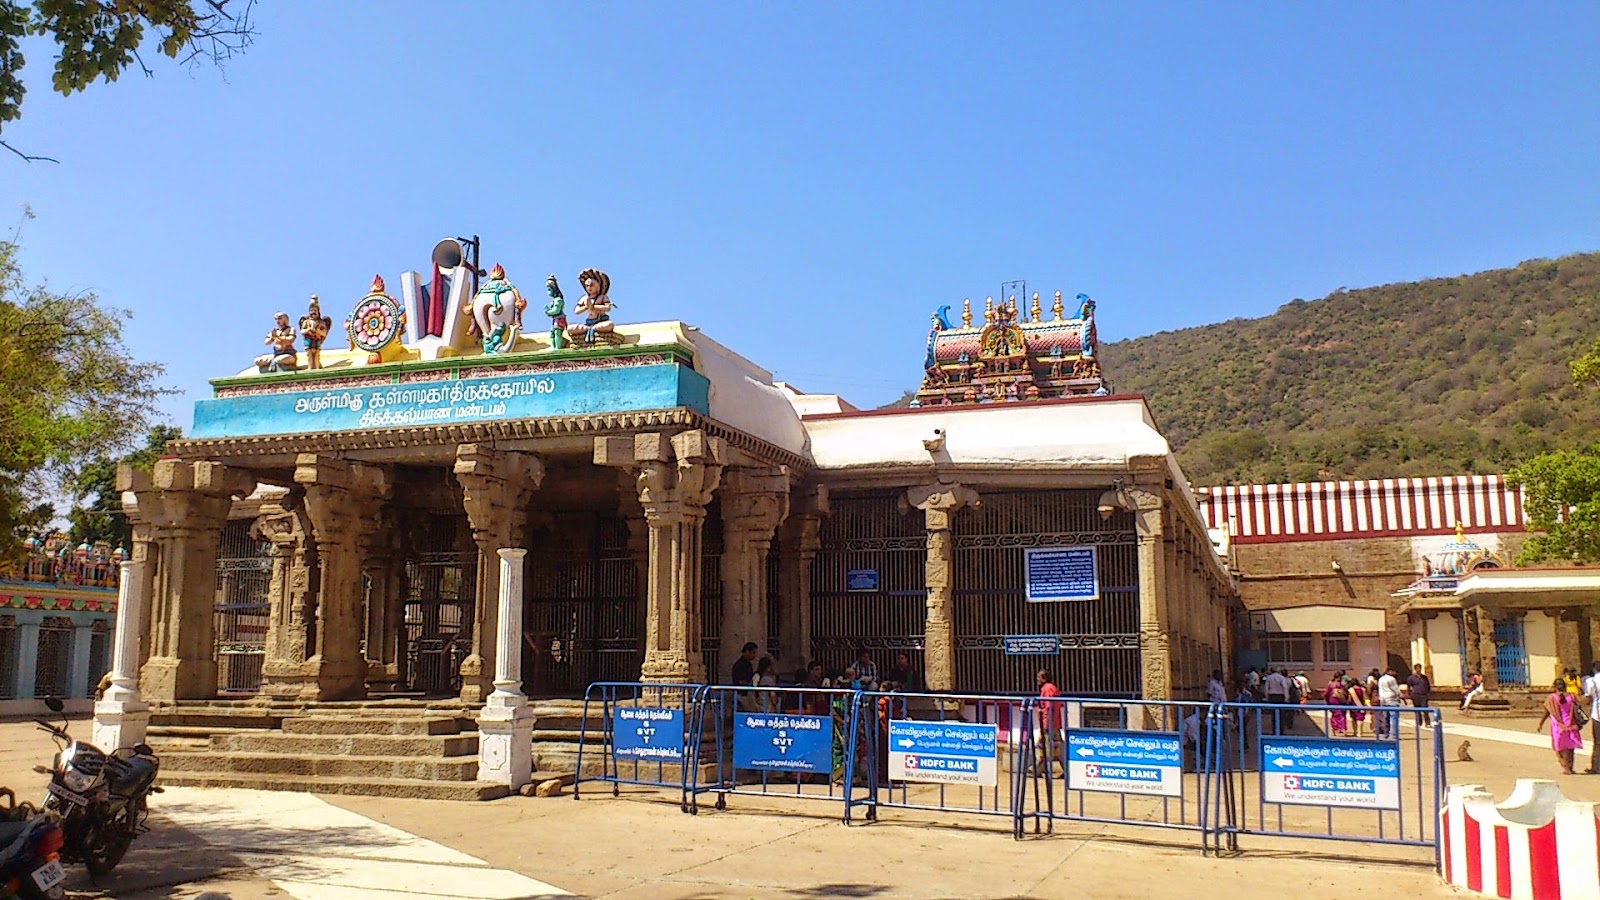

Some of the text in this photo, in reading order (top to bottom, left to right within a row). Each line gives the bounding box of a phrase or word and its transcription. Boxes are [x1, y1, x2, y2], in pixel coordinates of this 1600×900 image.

[295, 392, 363, 413] அருள்மிகு
[359, 400, 507, 429] திருக்கல்யாண மண்டபம்
[643, 736, 649, 744] T
[891, 726, 994, 743] கோவிலுக்குள் செல்லும் வழி
[773, 738, 793, 746] SVT
[1069, 736, 1179, 752] கோவிலுக்குள் செல்லும் வழி
[780, 746, 786, 754] T
[1264, 745, 1395, 762] கோவிலுக்குள் செல்லும் வழி
[920, 759, 974, 770] HDFC BANK
[1101, 768, 1158, 779] HDFC BANK
[1097, 781, 1129, 789] understand
[1303, 779, 1370, 791] HDFC BANK
[1297, 792, 1336, 801] understand
